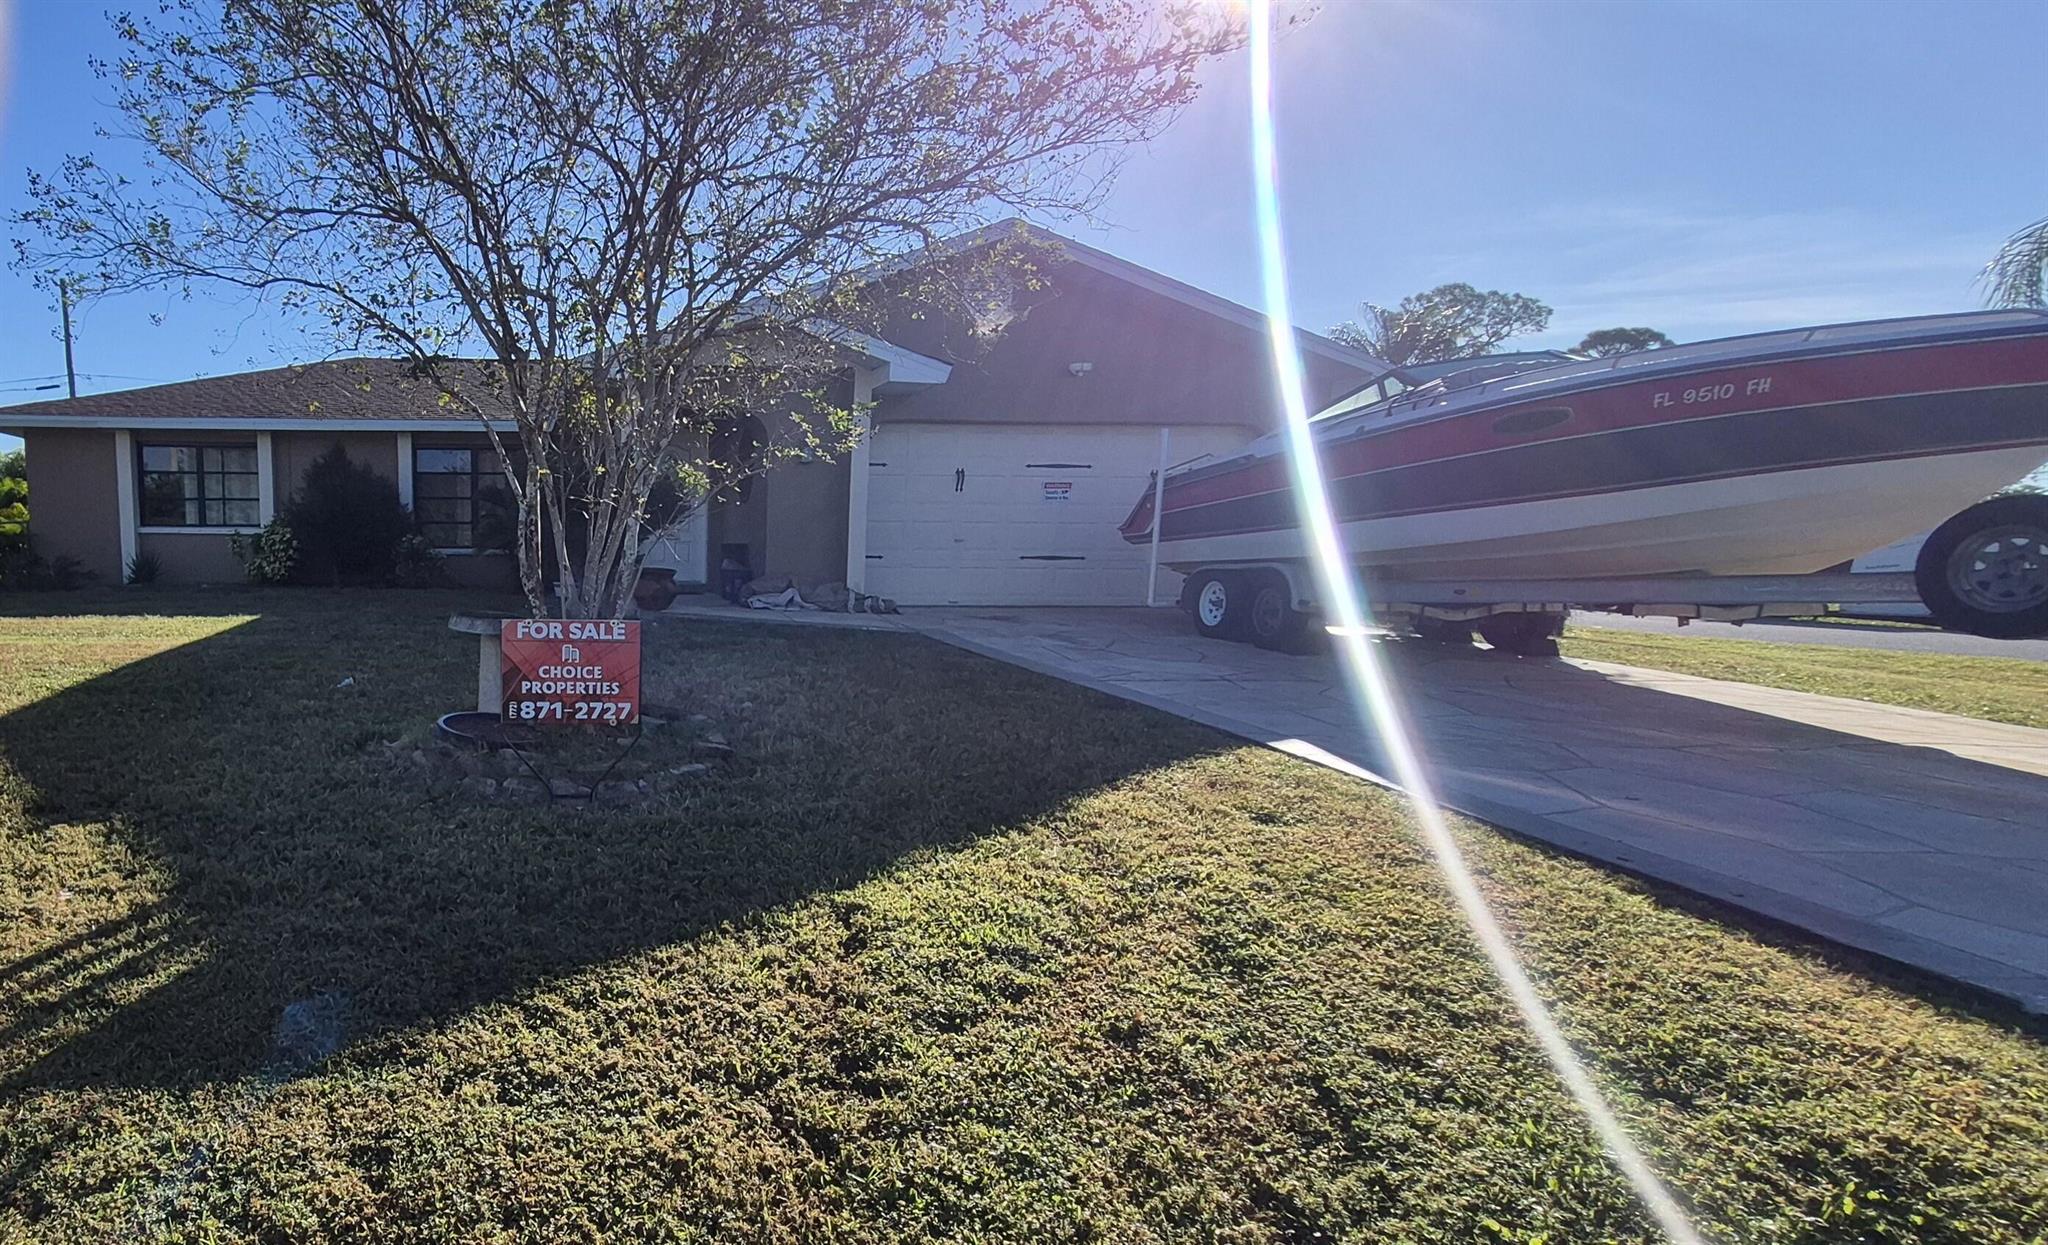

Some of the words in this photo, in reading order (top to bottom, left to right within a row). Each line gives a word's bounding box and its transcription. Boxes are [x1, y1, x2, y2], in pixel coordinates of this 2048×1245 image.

[1653, 392, 1675, 408] FL
[1683, 383, 1735, 404] 9510
[1746, 376, 1772, 396] FH
[517, 622, 564, 639] FOR
[569, 622, 626, 640] SALE
[538, 665, 602, 679] CHOICE
[521, 681, 620, 695] PROPERTIES
[520, 701, 632, 720] 871-2727
